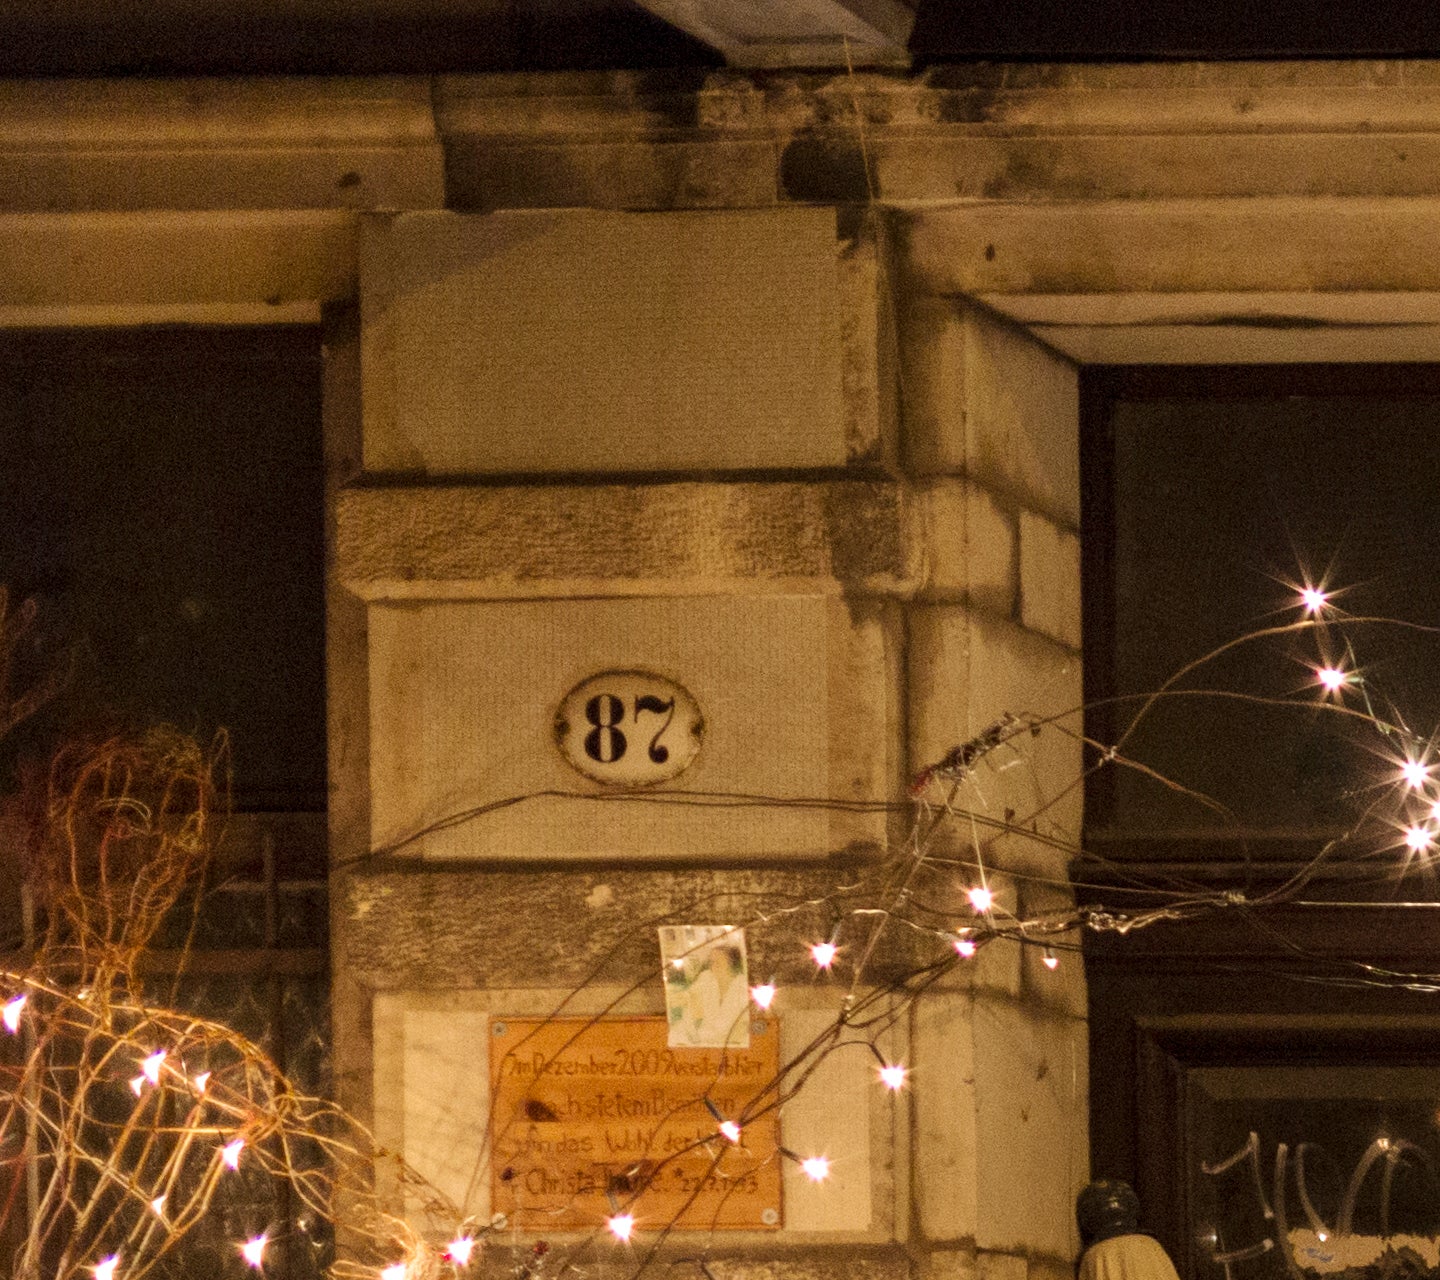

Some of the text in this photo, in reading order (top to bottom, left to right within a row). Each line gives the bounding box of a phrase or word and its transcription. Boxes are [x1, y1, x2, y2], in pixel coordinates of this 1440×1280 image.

[584, 693, 676, 764] 87
[532, 1052, 613, 1076] Dezember
[614, 1048, 674, 1075] 2009
